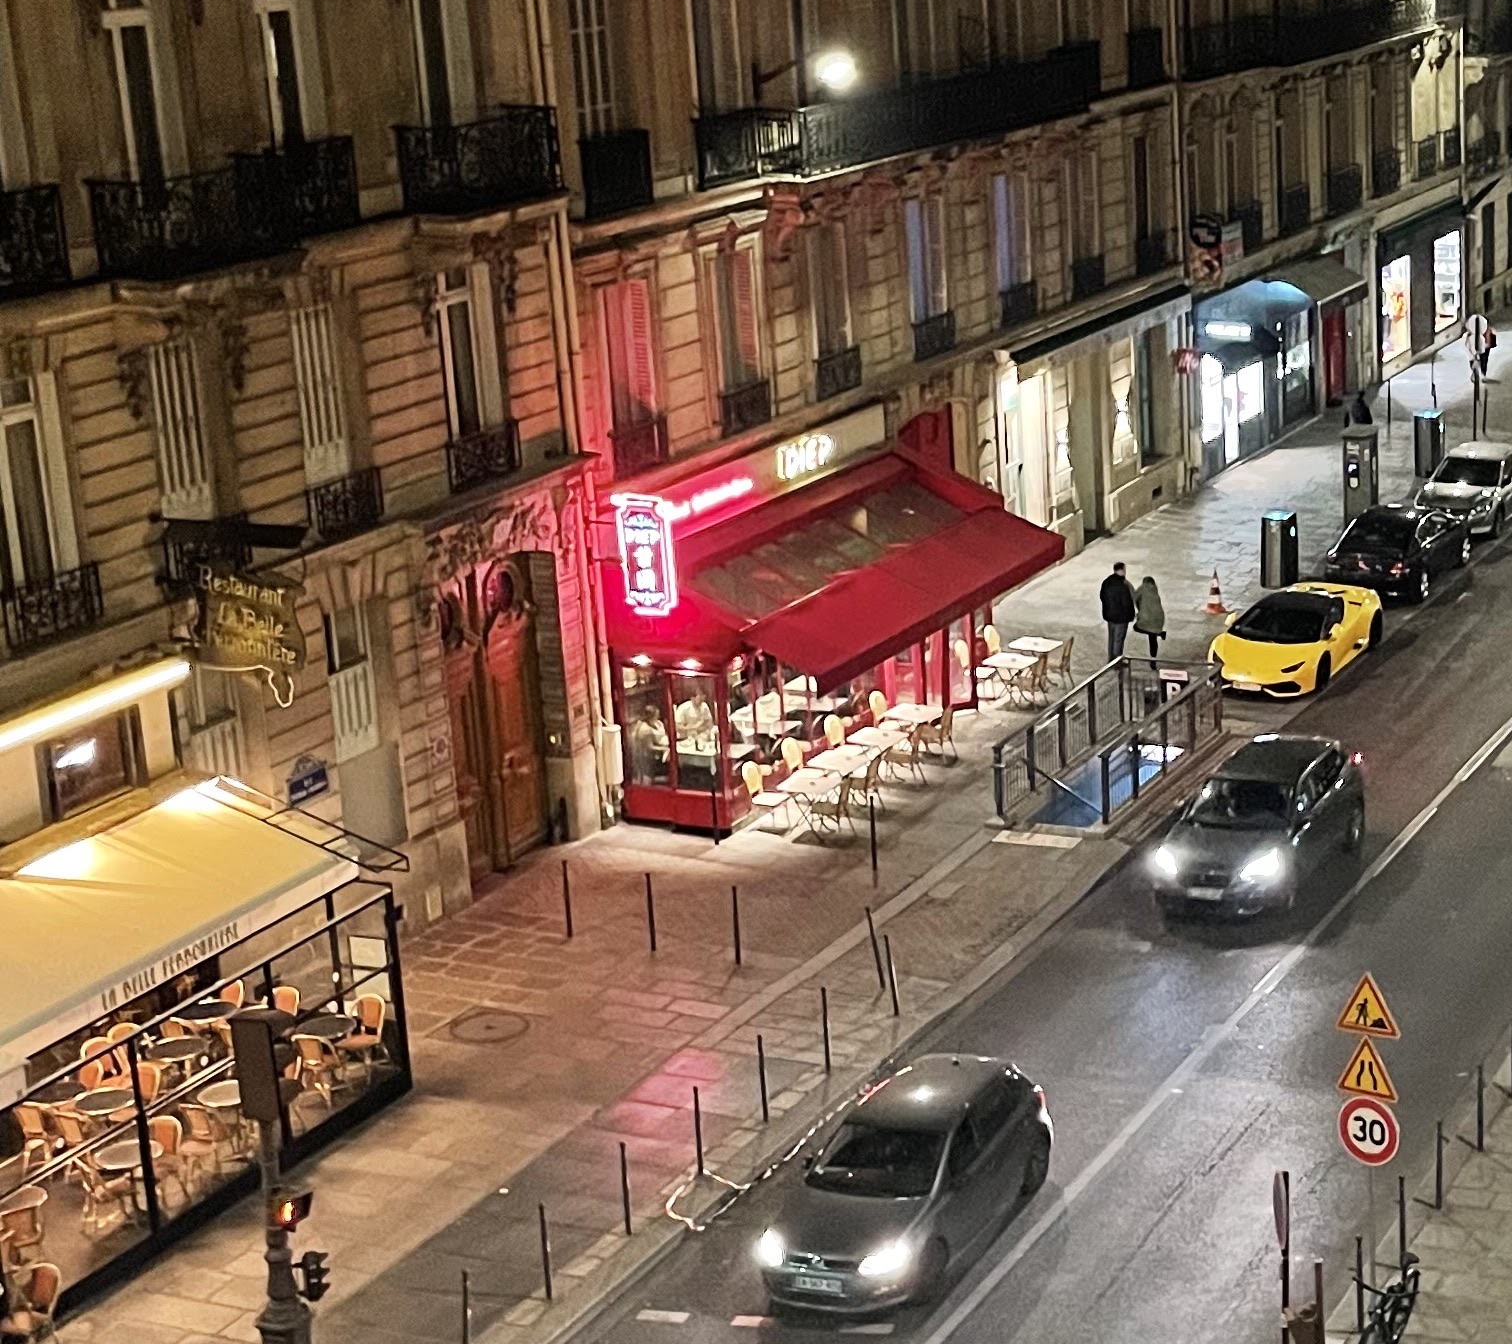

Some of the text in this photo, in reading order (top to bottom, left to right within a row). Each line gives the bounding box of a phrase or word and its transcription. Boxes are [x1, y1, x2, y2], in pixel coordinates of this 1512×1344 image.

[199, 563, 285, 606] Restaurant
[241, 607, 285, 638] Belle
[1352, 1115, 1386, 1146] 30
